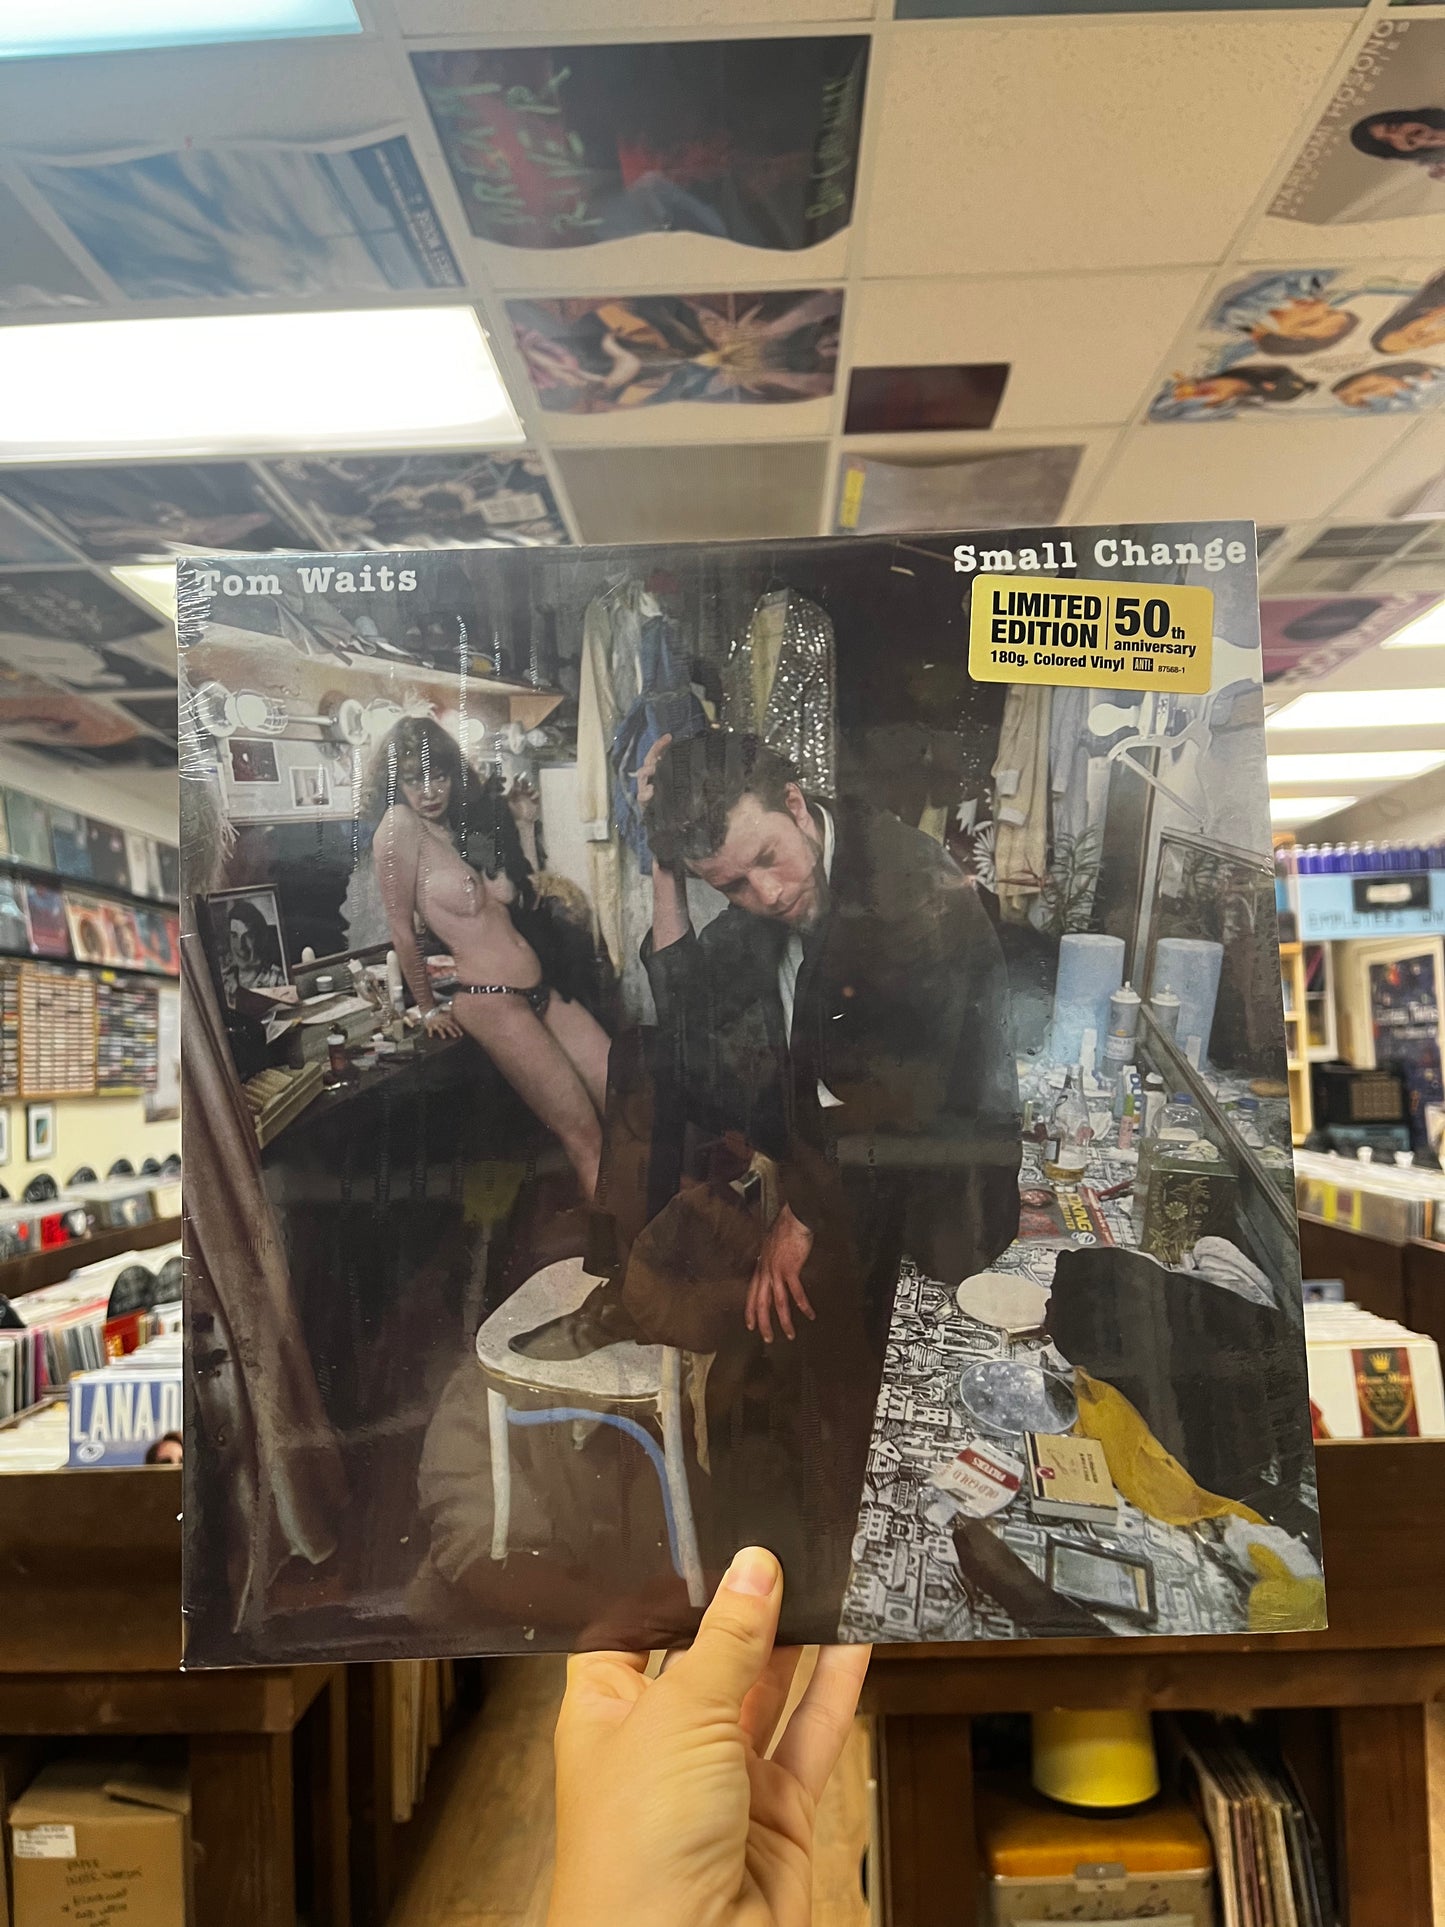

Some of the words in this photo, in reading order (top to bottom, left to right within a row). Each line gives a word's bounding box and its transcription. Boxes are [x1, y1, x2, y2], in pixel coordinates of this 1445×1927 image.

[1329, 20, 1394, 118] HOSONO
[953, 541, 1077, 572] Small
[1094, 538, 1246, 572] Change
[195, 570, 283, 597] Tom
[297, 564, 417, 594] Waits
[992, 590, 1101, 620] LIMITED
[991, 618, 1098, 649] EDITION
[1113, 639, 1197, 658] anniversary
[990, 649, 1028, 666] 180g.
[1033, 652, 1087, 669] Colored
[1090, 655, 1125, 673] Vinyl
[1157, 665, 1186, 674] 87568-1
[72, 1383, 154, 1441] LANA
